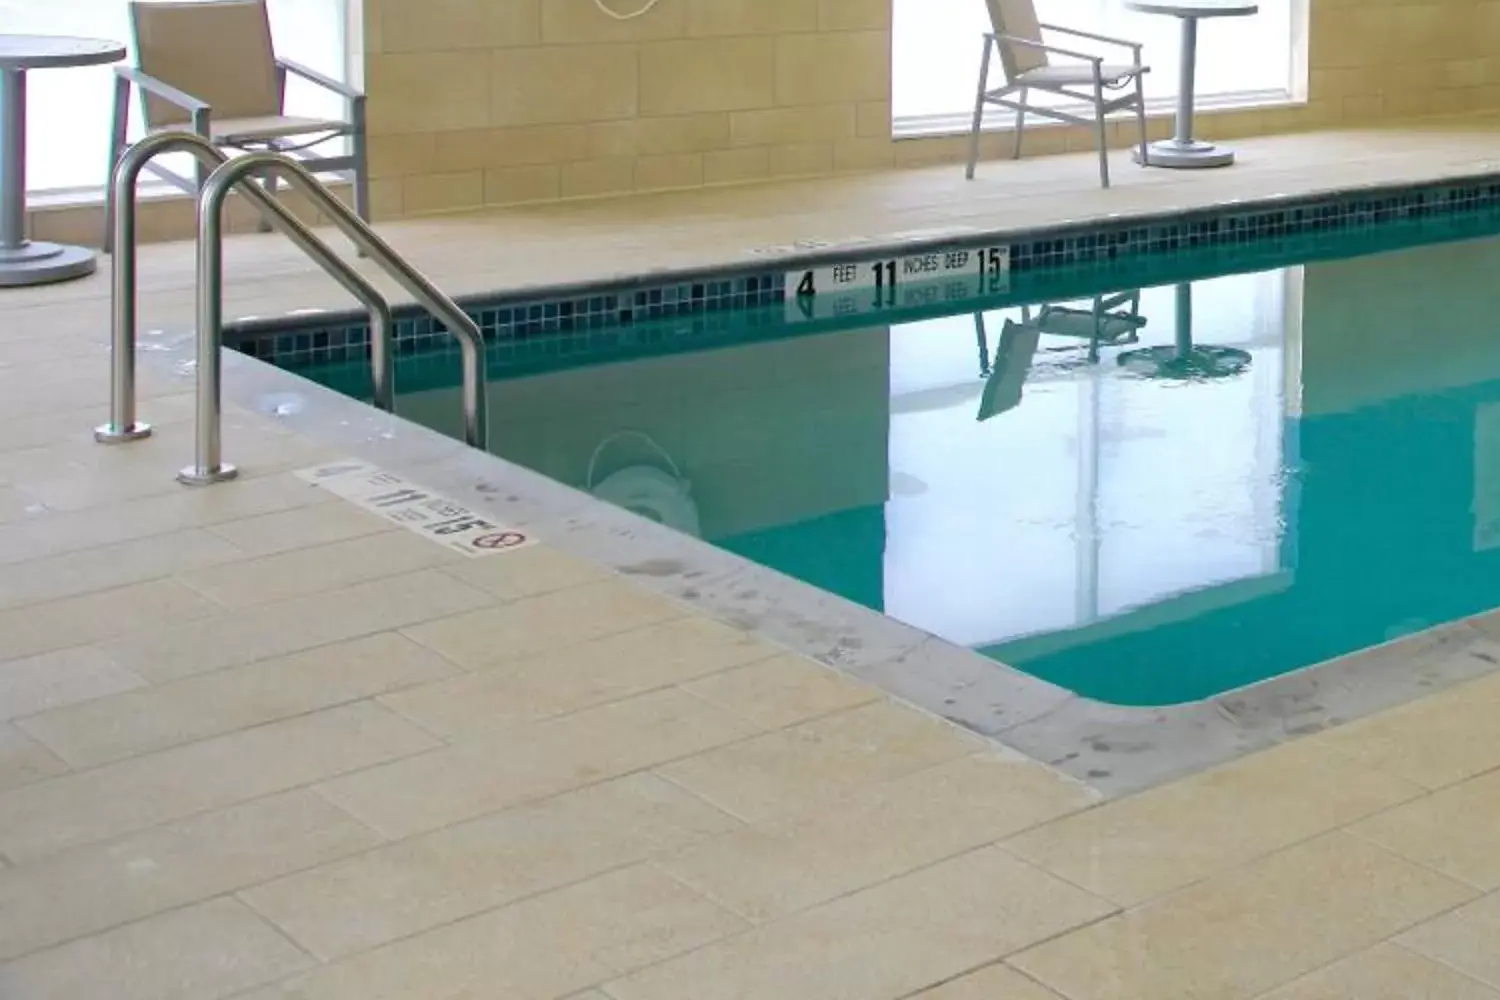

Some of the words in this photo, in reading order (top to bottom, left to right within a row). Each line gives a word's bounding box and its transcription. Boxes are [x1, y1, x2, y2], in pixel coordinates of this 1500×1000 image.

[797, 270, 816, 296] 4
[833, 263, 857, 283] FEET
[871, 260, 897, 288] 11
[903, 254, 938, 274] INCHES
[945, 251, 969, 269] DEEP
